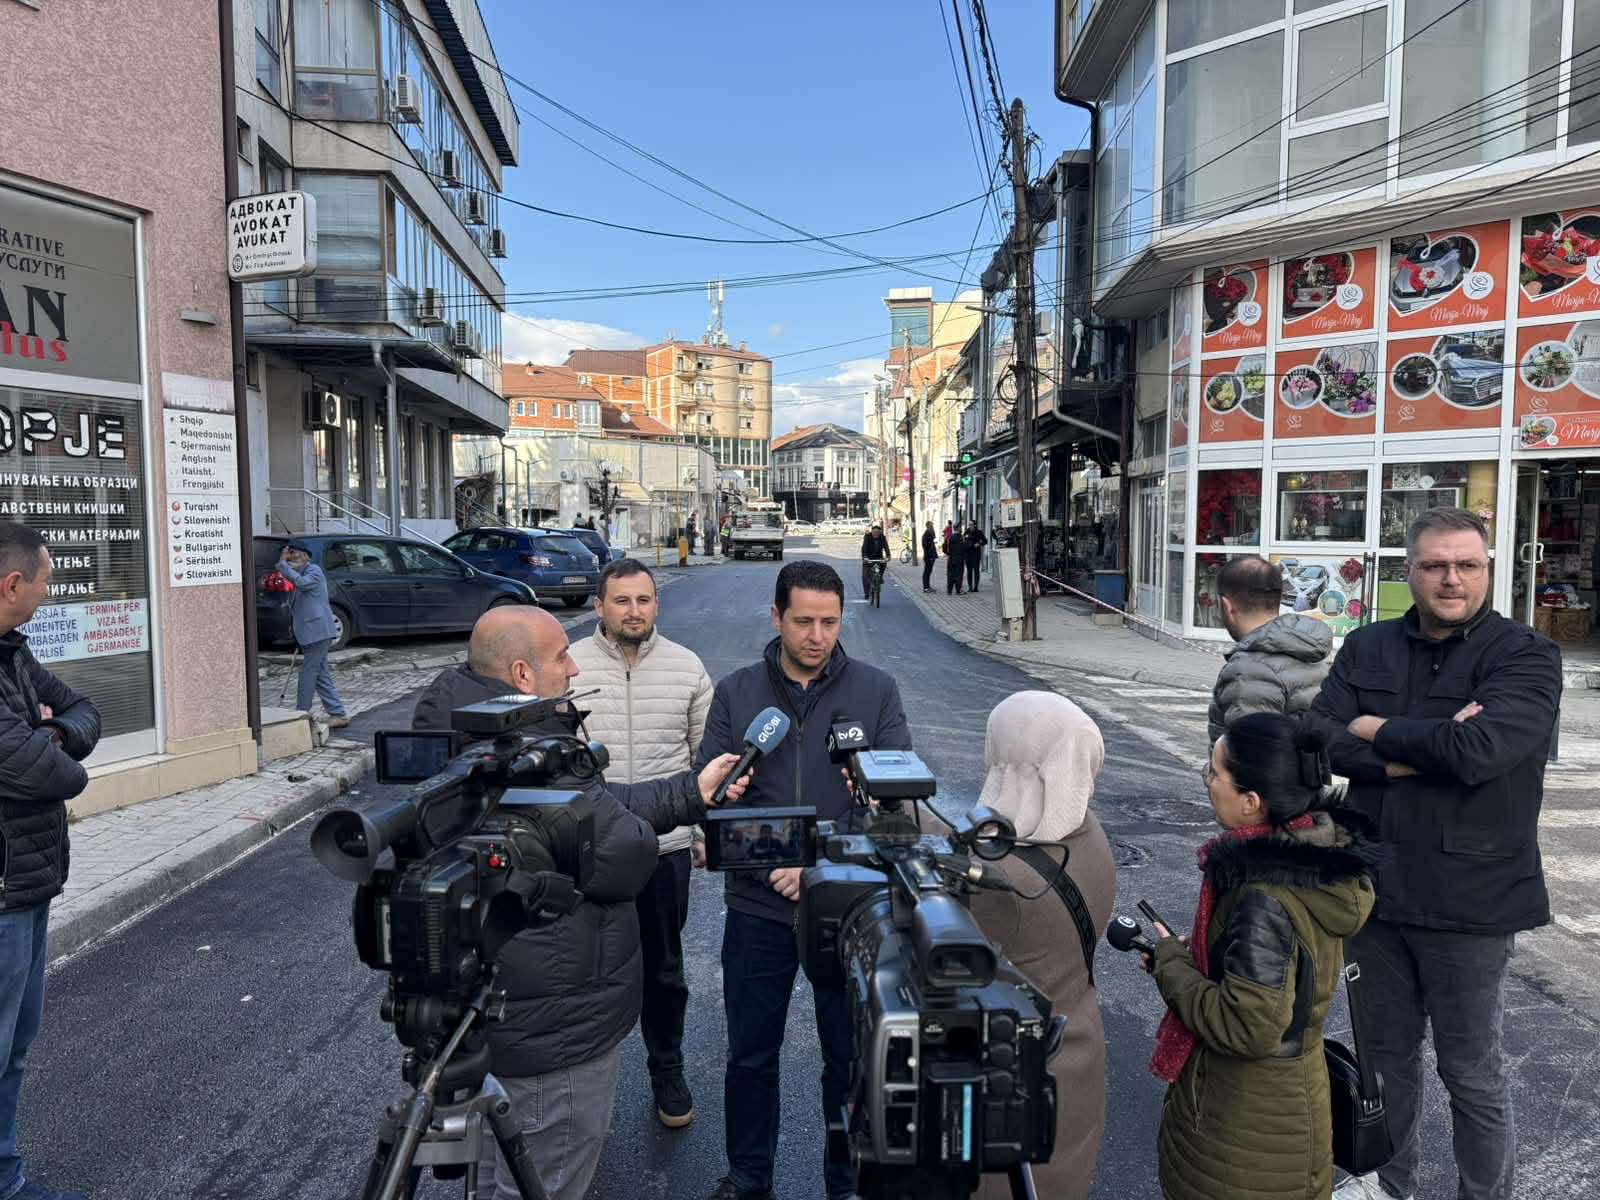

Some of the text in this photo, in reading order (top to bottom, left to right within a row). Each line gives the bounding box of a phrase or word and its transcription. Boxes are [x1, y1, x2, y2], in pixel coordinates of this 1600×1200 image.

[230, 197, 297, 219] АДВОКАТ
[234, 214, 292, 235] AVOKAT
[237, 230, 286, 249] AVUKAT
[180, 415, 203, 426] Shqip
[180, 428, 232, 440] Maqedonisht
[181, 441, 232, 452] Gjermanisht
[181, 454, 216, 464] Anglisht
[63, 475, 80, 488] НА
[83, 476, 137, 490] ОБРАЗЦИ
[182, 479, 224, 490] Frengjisht
[74, 503, 124, 514] КНИШКИ
[184, 502, 218, 512] Turqisht
[184, 516, 231, 525] Sllovenisht
[69, 529, 140, 541] МАТЕРИАЛИ
[184, 529, 224, 538] Kroatisht
[185, 543, 232, 553] Bullgarisht
[185, 557, 222, 565] Sërbisht
[186, 569, 232, 579] Sllovakisht
[32, 607, 60, 620] OSJA
[84, 603, 122, 615] TERMINE
[97, 616, 116, 627] VIZA
